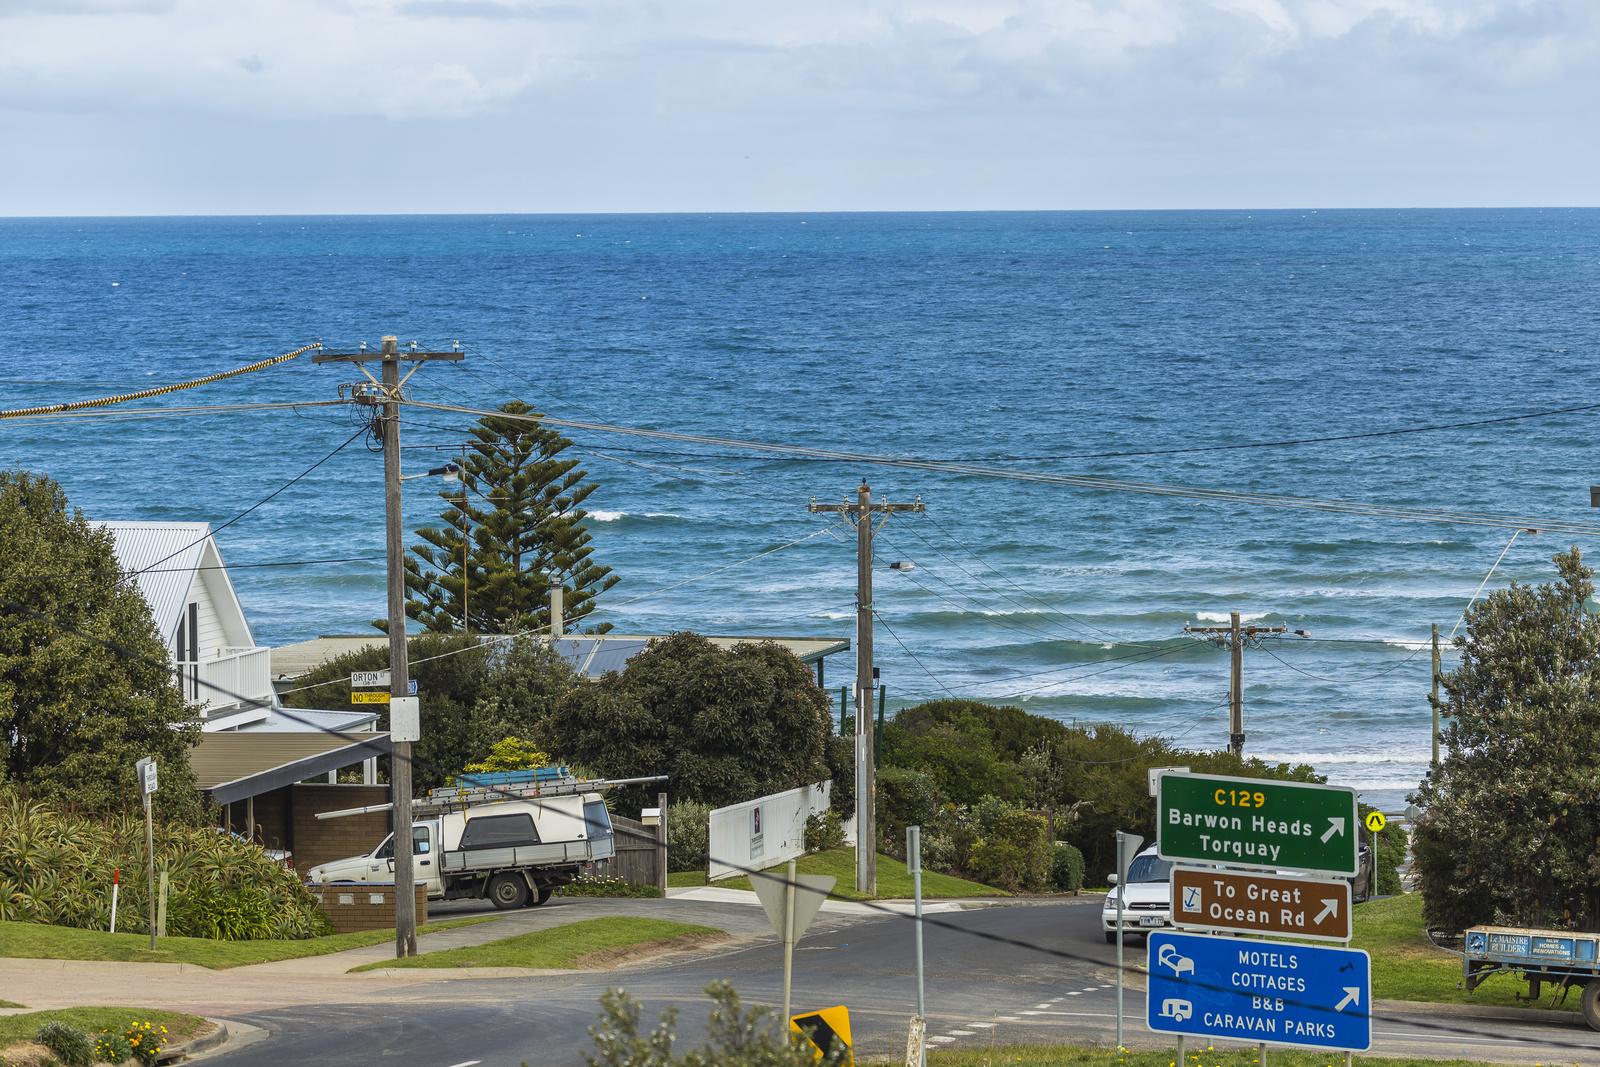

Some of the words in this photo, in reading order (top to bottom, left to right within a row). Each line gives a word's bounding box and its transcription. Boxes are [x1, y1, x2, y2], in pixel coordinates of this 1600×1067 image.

[353, 672, 378, 682] ORTON
[353, 693, 363, 703] NO
[1214, 788, 1265, 808] C129
[1169, 808, 1242, 831] Barwon
[1252, 815, 1312, 837] Heads
[1199, 834, 1281, 862] Torquay
[1213, 880, 1236, 898] To
[1246, 883, 1301, 904] Great
[1209, 902, 1270, 924] Ocean
[1280, 908, 1305, 927] Rd
[1491, 943, 1526, 954] BUILDERS
[1499, 935, 1529, 946] MAISTRE
[1239, 950, 1298, 970] MOTELS
[1533, 948, 1571, 956] RENOVATIONS
[1231, 971, 1306, 992] COTTAGES
[1252, 996, 1285, 1012] B&B
[1203, 1012, 1276, 1033] CARAVAN
[1285, 1019, 1336, 1039] PARKS
